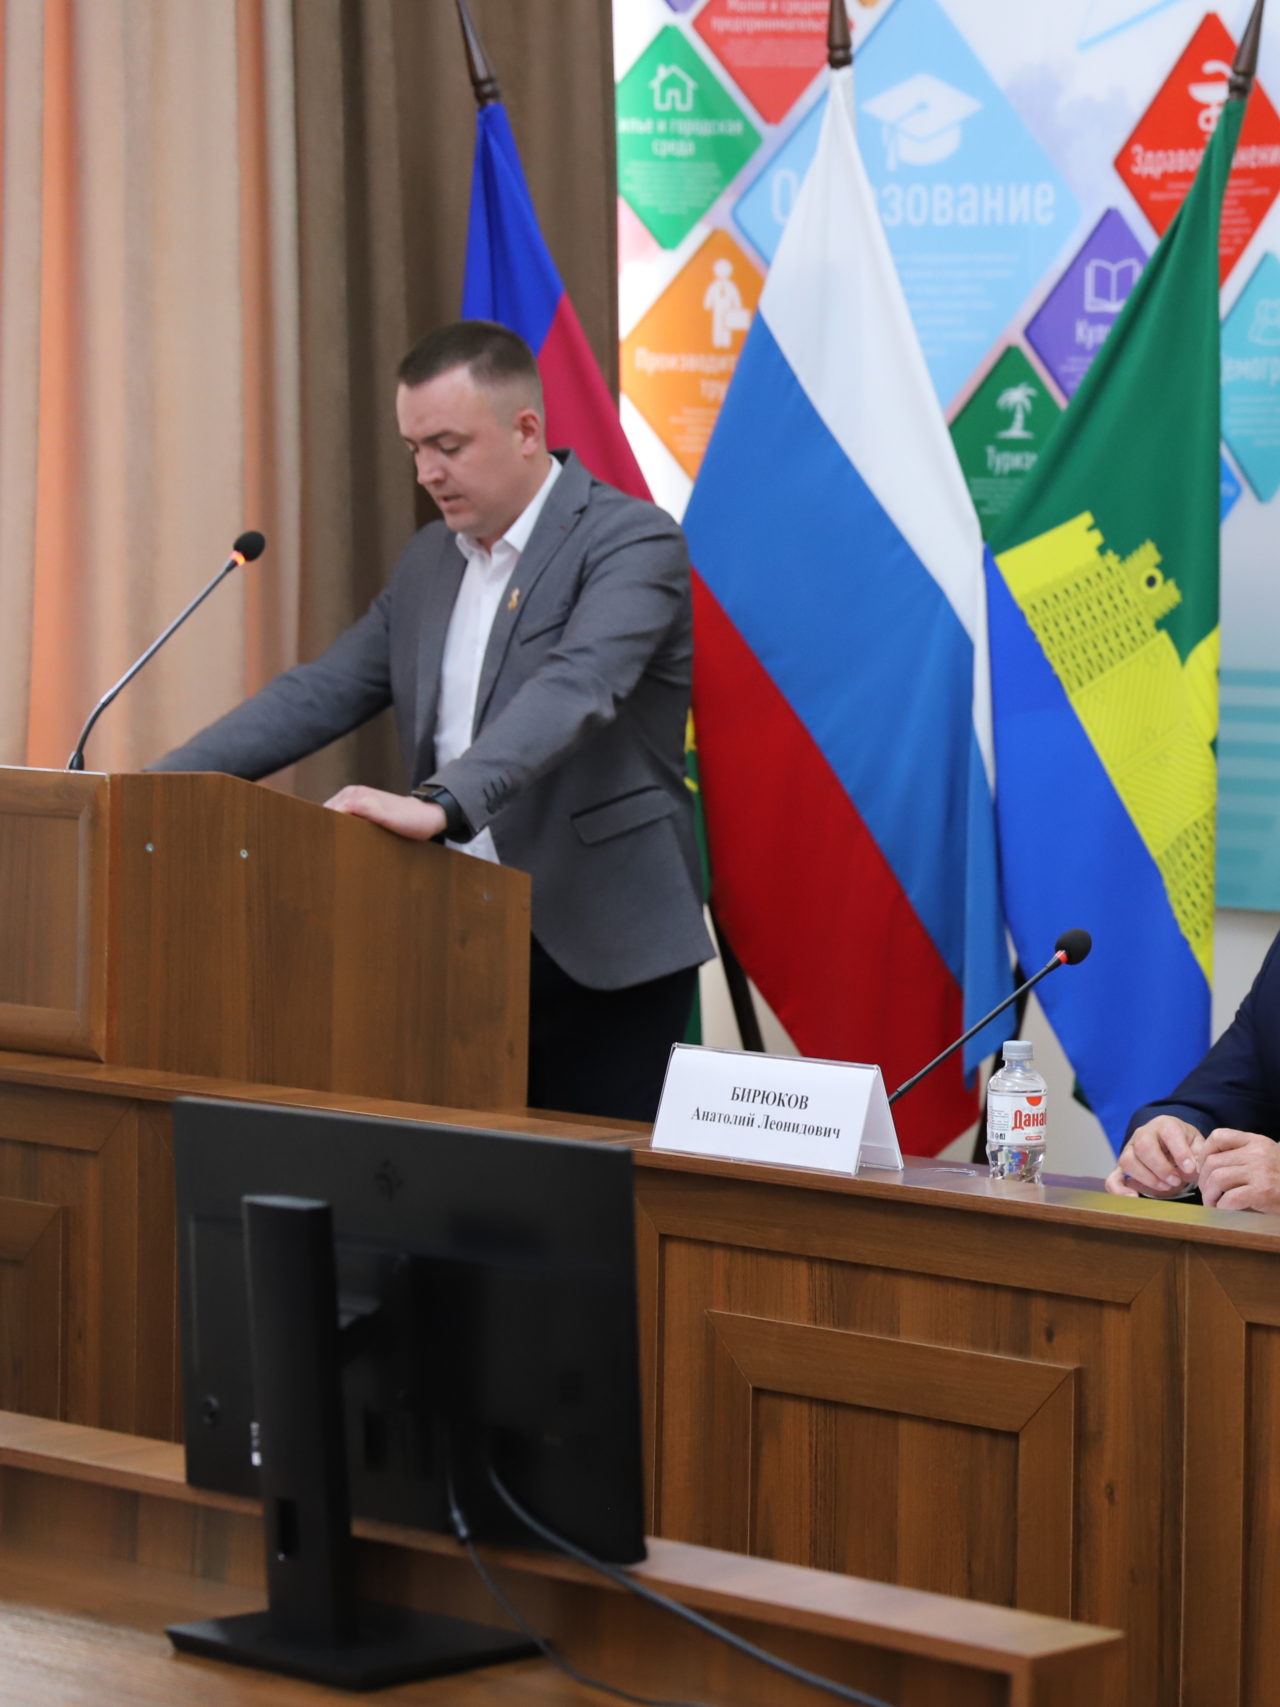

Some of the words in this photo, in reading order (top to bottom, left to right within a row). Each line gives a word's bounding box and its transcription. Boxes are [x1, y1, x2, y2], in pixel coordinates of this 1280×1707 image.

[771, 168, 1056, 227] Озование
[985, 445, 1037, 476] Туриз
[730, 1086, 810, 1110] БИРЮКОВ
[690, 1106, 755, 1128] Анатолий
[757, 1113, 841, 1139] Леонидович
